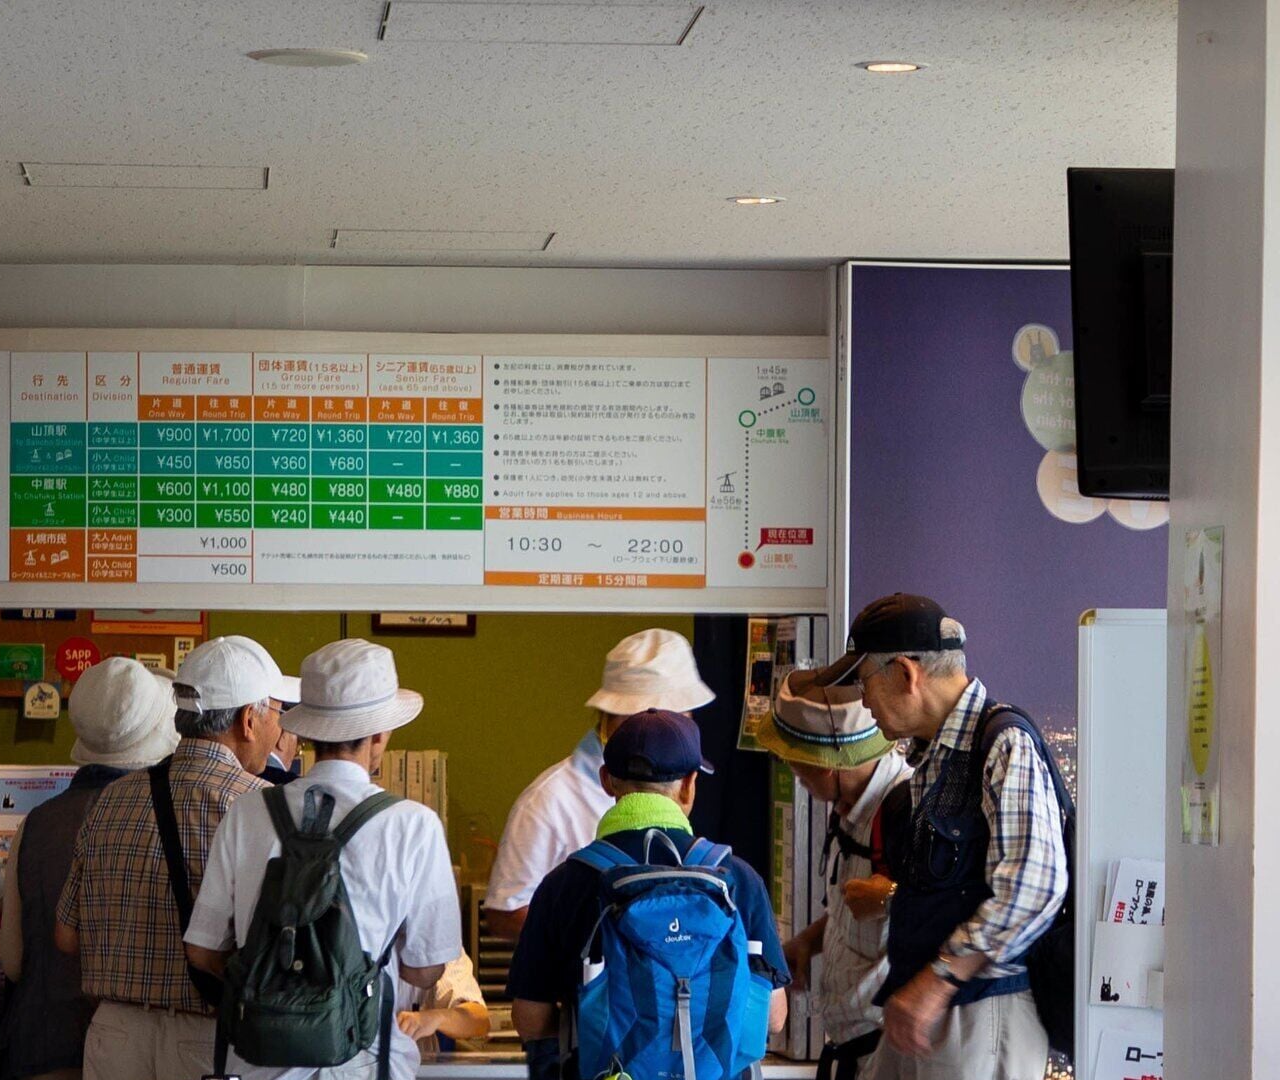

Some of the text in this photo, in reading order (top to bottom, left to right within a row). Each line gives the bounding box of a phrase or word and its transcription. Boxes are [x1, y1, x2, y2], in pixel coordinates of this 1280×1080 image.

[171, 362, 221, 375] 普通運賃
[162, 375, 230, 386] Regular Fare
[281, 373, 341, 384] Group Fare
[395, 374, 457, 384] Senior Fare
[320, 383, 360, 393] persons)
[420, 384, 438, 392] and
[21, 391, 79, 401] Destination
[92, 391, 133, 401] Division
[148, 409, 186, 419] One Way
[203, 409, 246, 420] Round Trip
[262, 410, 301, 420] One Way
[317, 411, 360, 421] Round Trip
[377, 412, 415, 421] One Way
[431, 412, 474, 422] Round Trip
[31, 425, 67, 436] 山頂駅
[92, 426, 111, 435] 大人
[157, 427, 192, 441] ¥900
[202, 427, 250, 443] ¥1,700
[271, 428, 307, 442] ¥720
[317, 429, 364, 444] ¥1,360
[386, 430, 421, 444] ¥720
[432, 430, 479, 445] ¥1,360
[92, 453, 111, 462] 小人
[157, 455, 192, 469] ¥450
[214, 455, 250, 469] ¥850
[271, 456, 307, 470] ¥360
[329, 456, 364, 471] ¥680
[31, 478, 67, 490] 中腹駅
[92, 479, 111, 488] 大人
[157, 482, 192, 496] ¥600
[202, 482, 250, 497] ¥1,100
[271, 482, 307, 497] ¥480
[329, 483, 364, 497] ¥880
[386, 483, 421, 498] ¥480
[444, 484, 479, 499] ¥880
[92, 505, 111, 515] 小人
[157, 508, 192, 522] ¥300
[214, 508, 250, 523] ¥550
[271, 509, 307, 523] ¥240
[498, 508, 549, 520] 営業時間
[556, 511, 623, 520] Business Hours
[329, 510, 364, 524] ¥440
[26, 533, 67, 544] 札幌市民
[91, 533, 132, 542] 大人 Adult
[199, 536, 247, 550] ¥1,000
[507, 537, 563, 552] 10:30
[627, 539, 684, 553] 22:00
[91, 560, 132, 569] 小人 Child
[211, 563, 247, 576] ¥500
[538, 573, 648, 586] 定期運行 15分間隔
[65, 648, 92, 660] SAPP
[1114, 901, 1126, 923] 終日
[665, 934, 692, 943] deuter
